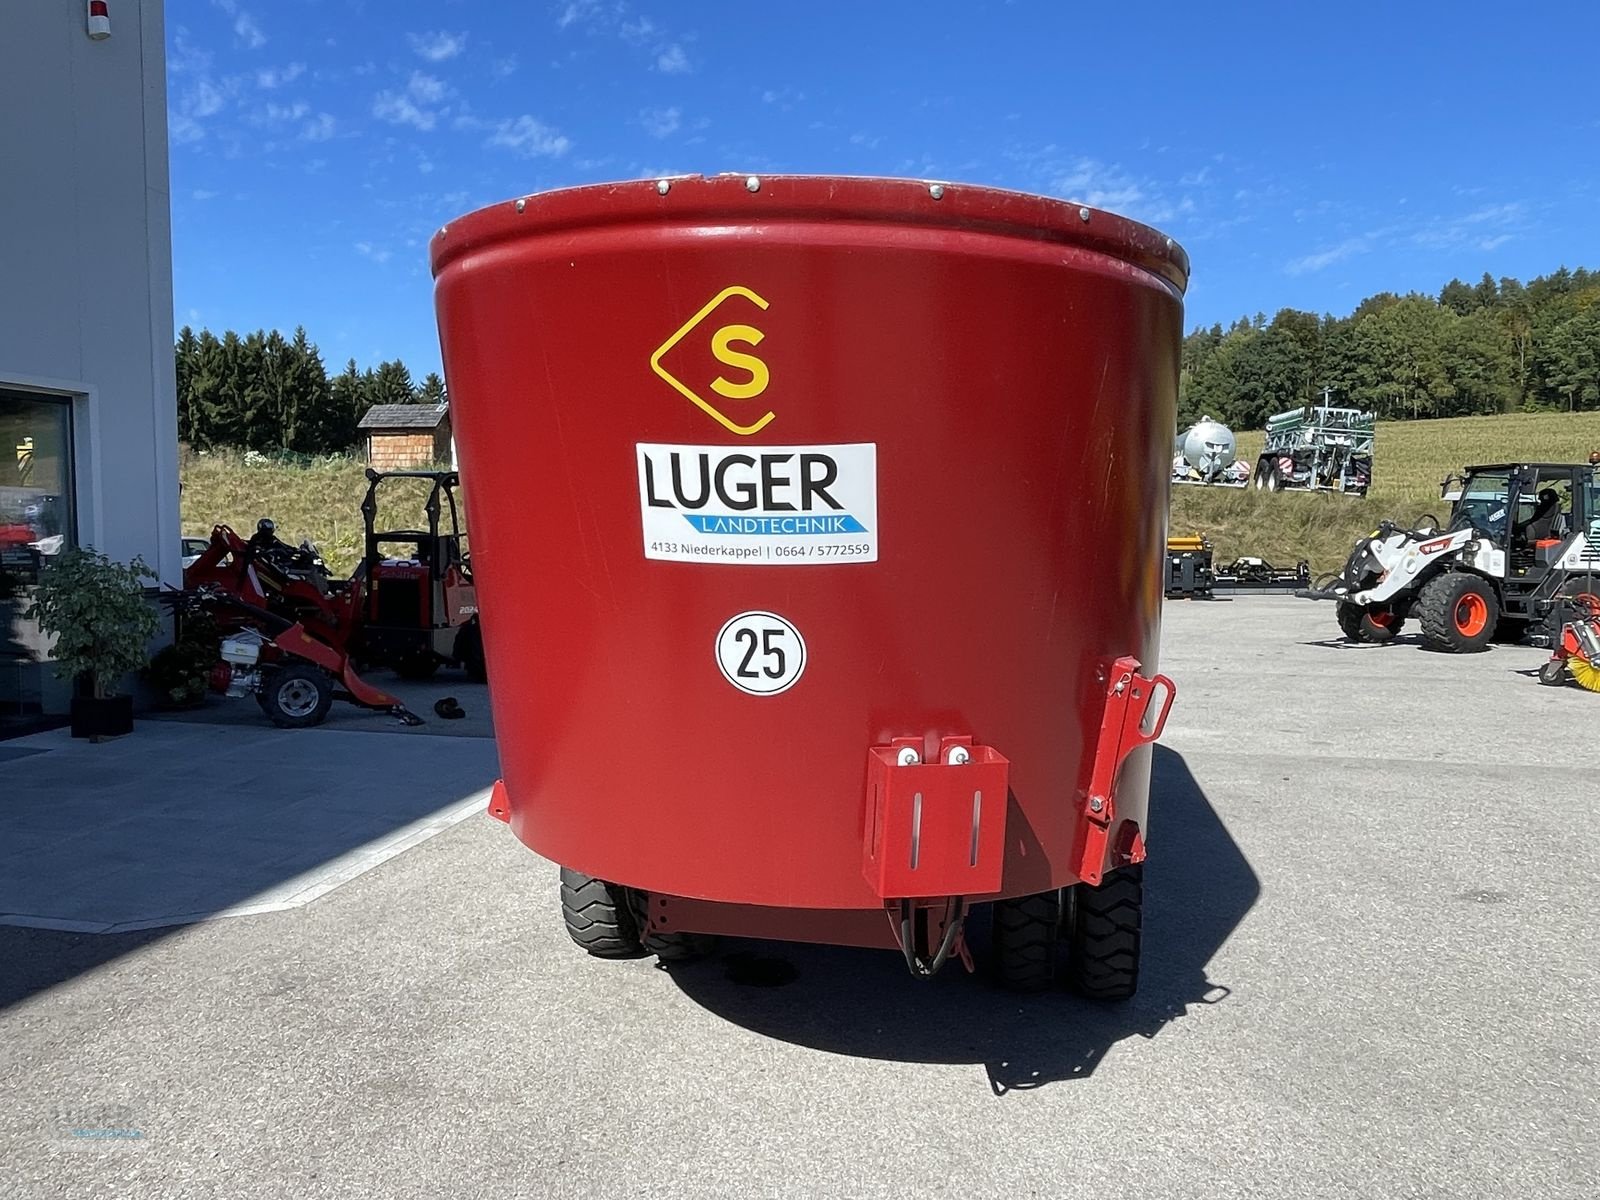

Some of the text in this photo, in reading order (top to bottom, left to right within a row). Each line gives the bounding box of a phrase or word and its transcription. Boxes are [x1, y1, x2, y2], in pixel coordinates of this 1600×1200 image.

[710, 324, 769, 399] S
[644, 452, 845, 511] LUGER
[651, 541, 678, 554] 4133
[681, 543, 762, 558] Niederkappel
[776, 546, 805, 557] 0664
[817, 544, 870, 555] 5772559
[702, 516, 846, 533] LANDTECHNIK
[735, 628, 785, 679] 25
